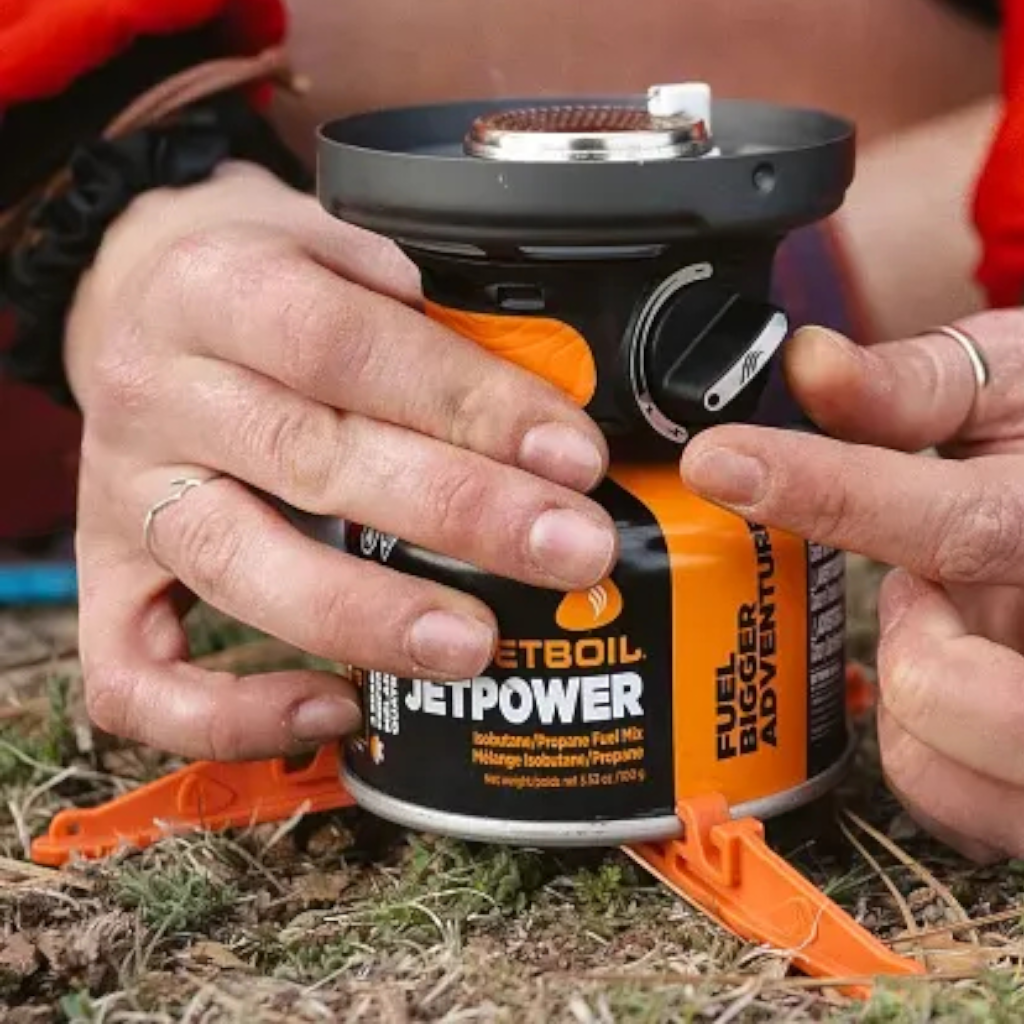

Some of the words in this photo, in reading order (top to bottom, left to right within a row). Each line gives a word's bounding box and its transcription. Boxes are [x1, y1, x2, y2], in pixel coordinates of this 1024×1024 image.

[496, 634, 645, 669] ETBOIL
[404, 671, 644, 724] JETPOWER
[737, 603, 759, 755] BIGGER
[715, 652, 737, 761] FUEL
[592, 728, 619, 747] Fuel
[620, 726, 644, 743] Mix
